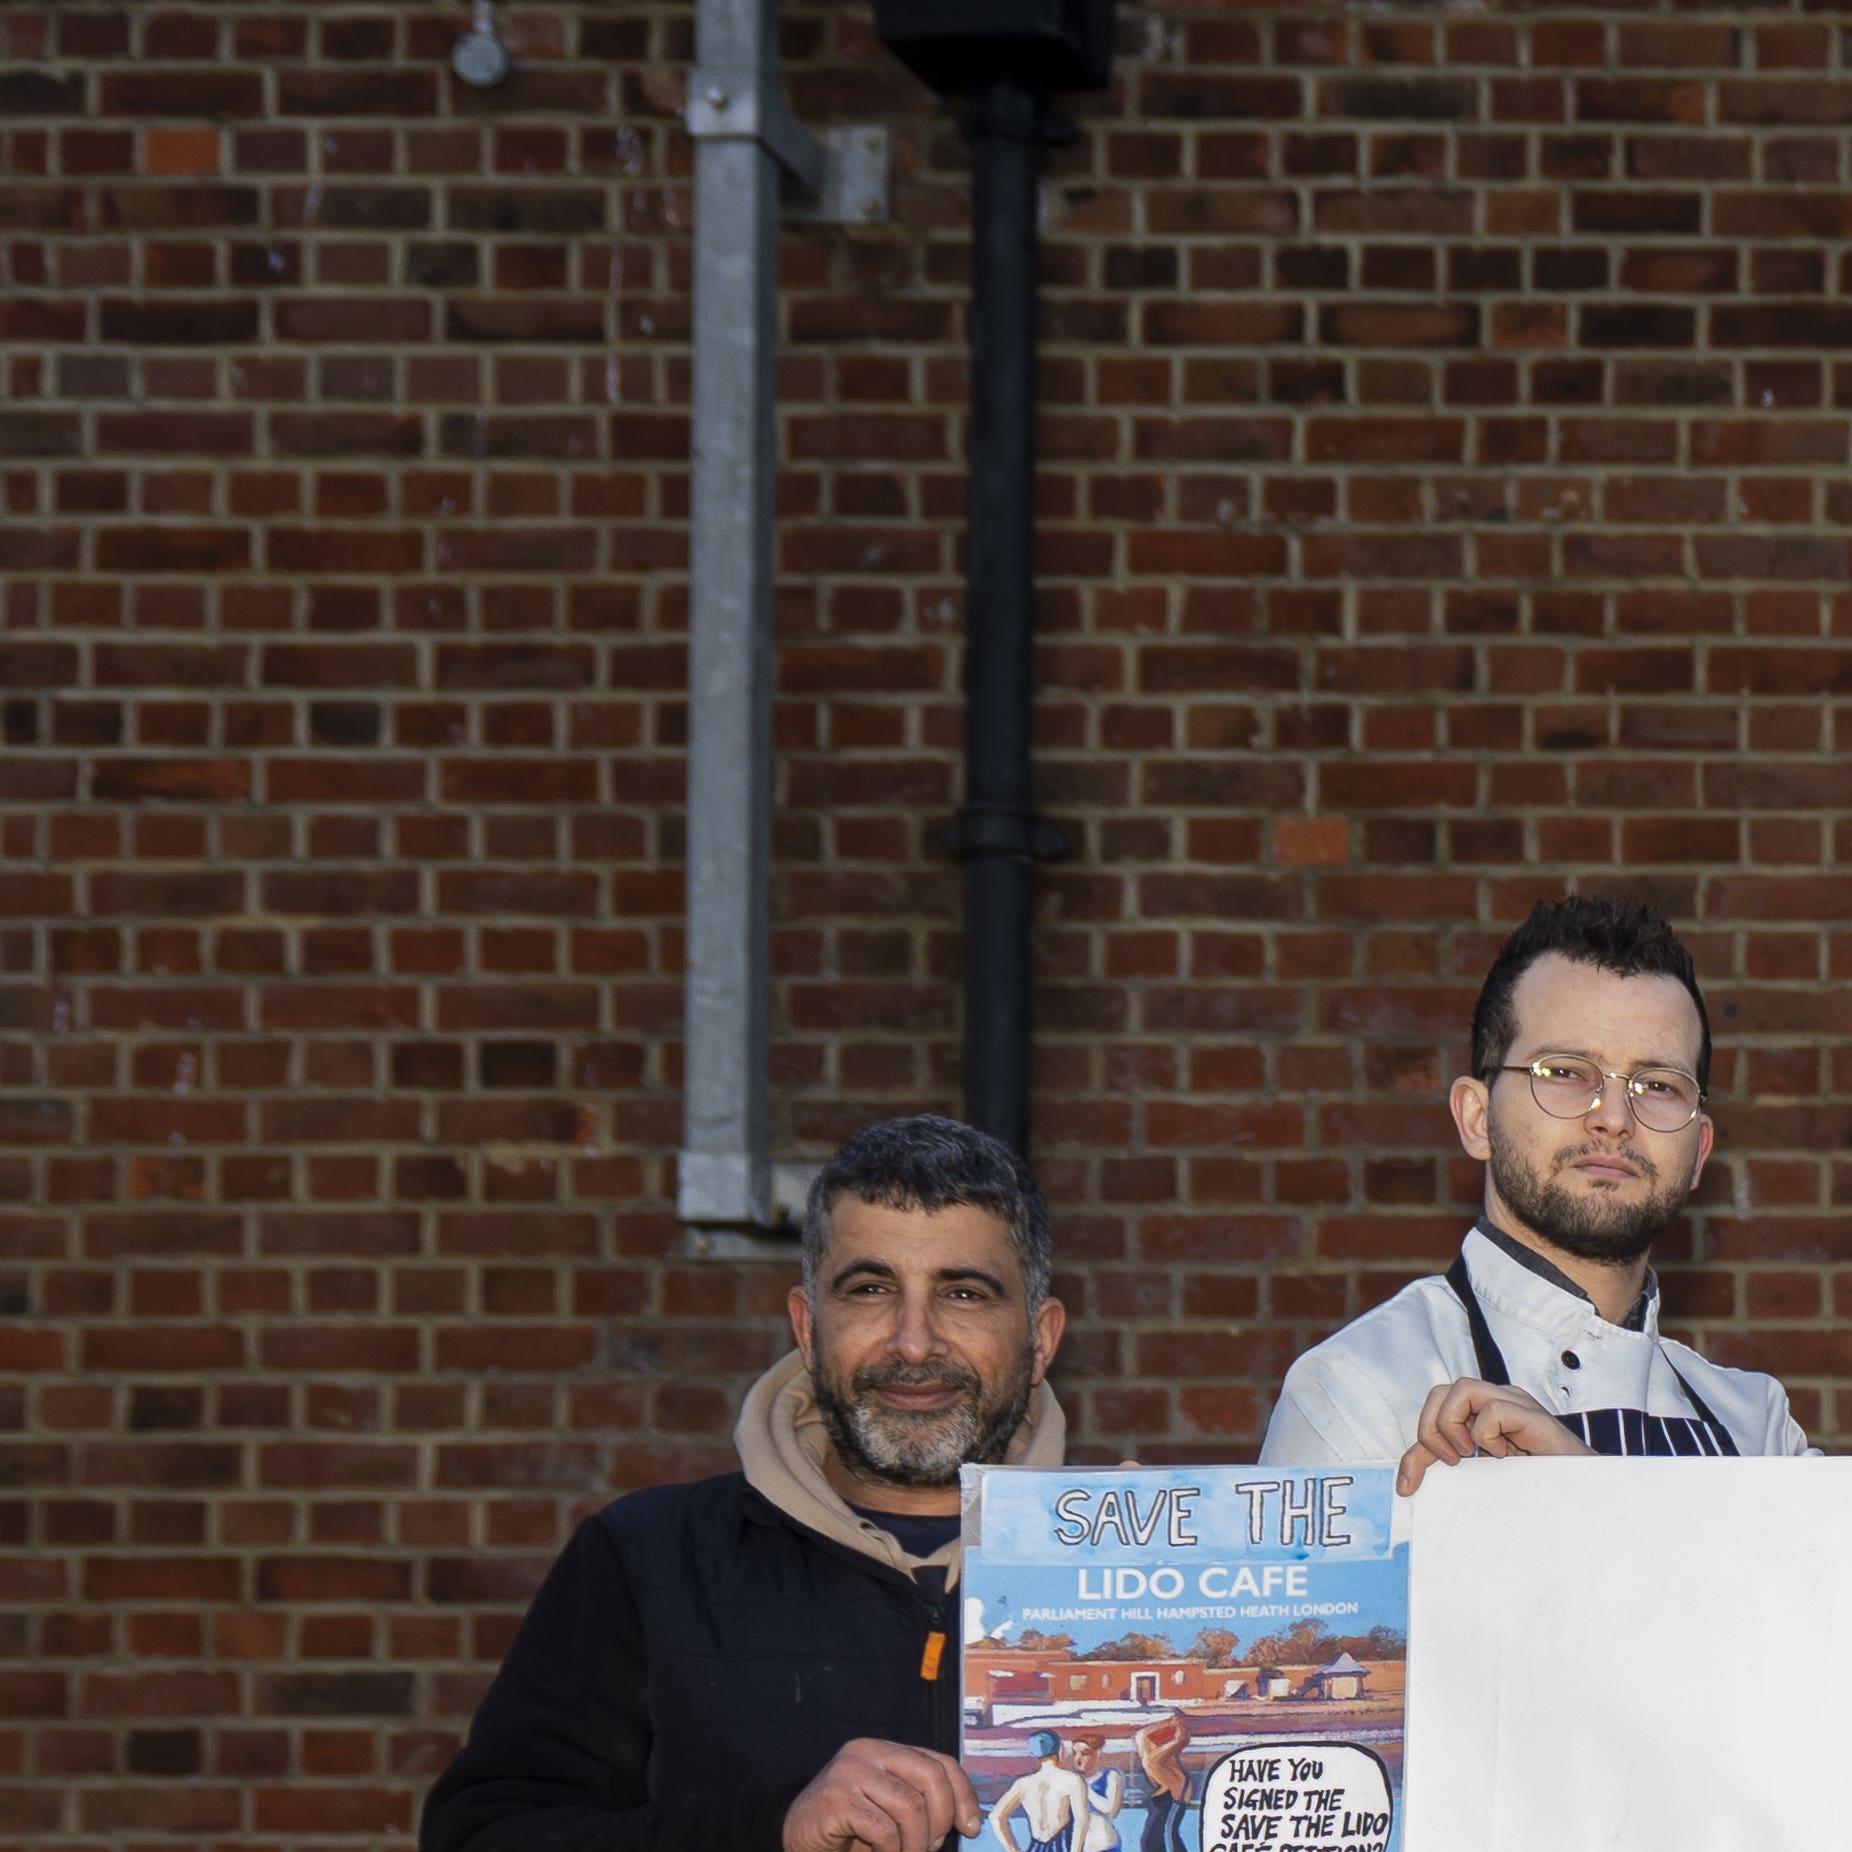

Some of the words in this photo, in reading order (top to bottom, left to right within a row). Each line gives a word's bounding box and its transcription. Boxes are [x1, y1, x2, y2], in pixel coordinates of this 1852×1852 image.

[1055, 1488, 1201, 1547] SAVE
[1236, 1476, 1354, 1547] THE
[1078, 1568, 1184, 1600] LIDO
[1199, 1565, 1308, 1598] CAFE
[1022, 1607, 1117, 1620] PARLIAMENT
[1121, 1608, 1153, 1619] HILL
[1157, 1606, 1236, 1619] HAMPSTED
[1240, 1604, 1289, 1617] HEATH
[1293, 1601, 1359, 1616] LONDON
[1229, 1758, 1281, 1782] HAVE
[1288, 1757, 1323, 1781] YOU
[1223, 1786, 1299, 1811] SIGNED
[1303, 1788, 1345, 1812] THE
[1221, 1813, 1282, 1840] SAVE
[1290, 1814, 1336, 1838] THE
[1341, 1811, 1388, 1837] LIDO
